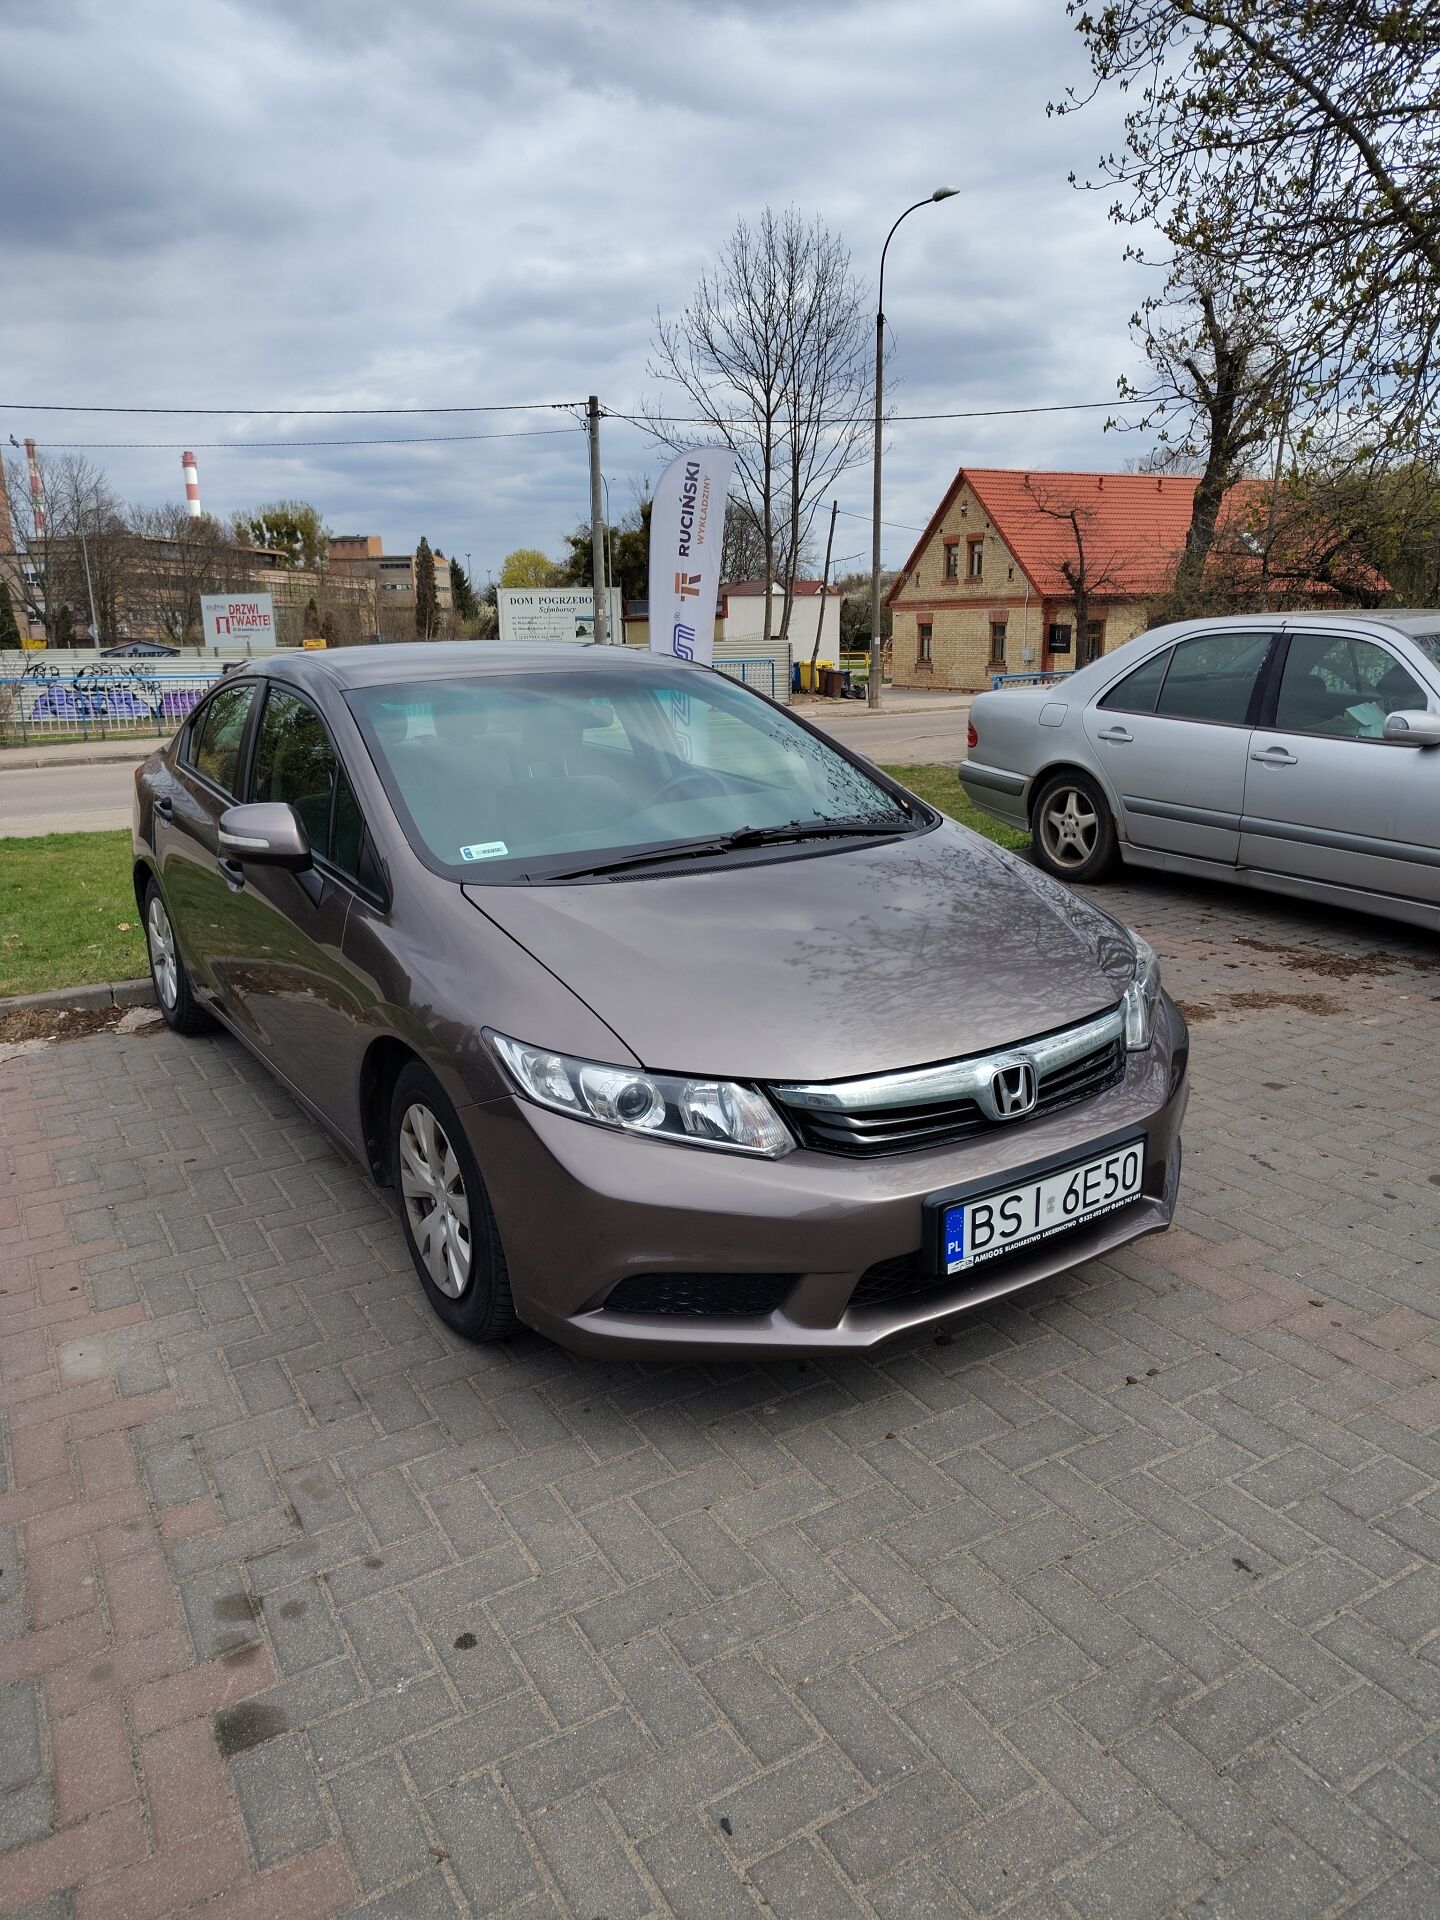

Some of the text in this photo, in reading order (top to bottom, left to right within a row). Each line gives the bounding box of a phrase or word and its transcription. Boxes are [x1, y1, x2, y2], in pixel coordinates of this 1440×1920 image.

[678, 461, 700, 557] RUCIŃSKI
[697, 475, 712, 545] WYKŁADZINY
[228, 603, 259, 615] DRZWI
[510, 596, 606, 605] DOM POGRZEBO
[971, 1151, 1138, 1251] BSI 6E50
[947, 1240, 961, 1255] PL
[974, 1247, 1004, 1263] AMIGOS
[1005, 1234, 1041, 1252] BLACHARSTWO
